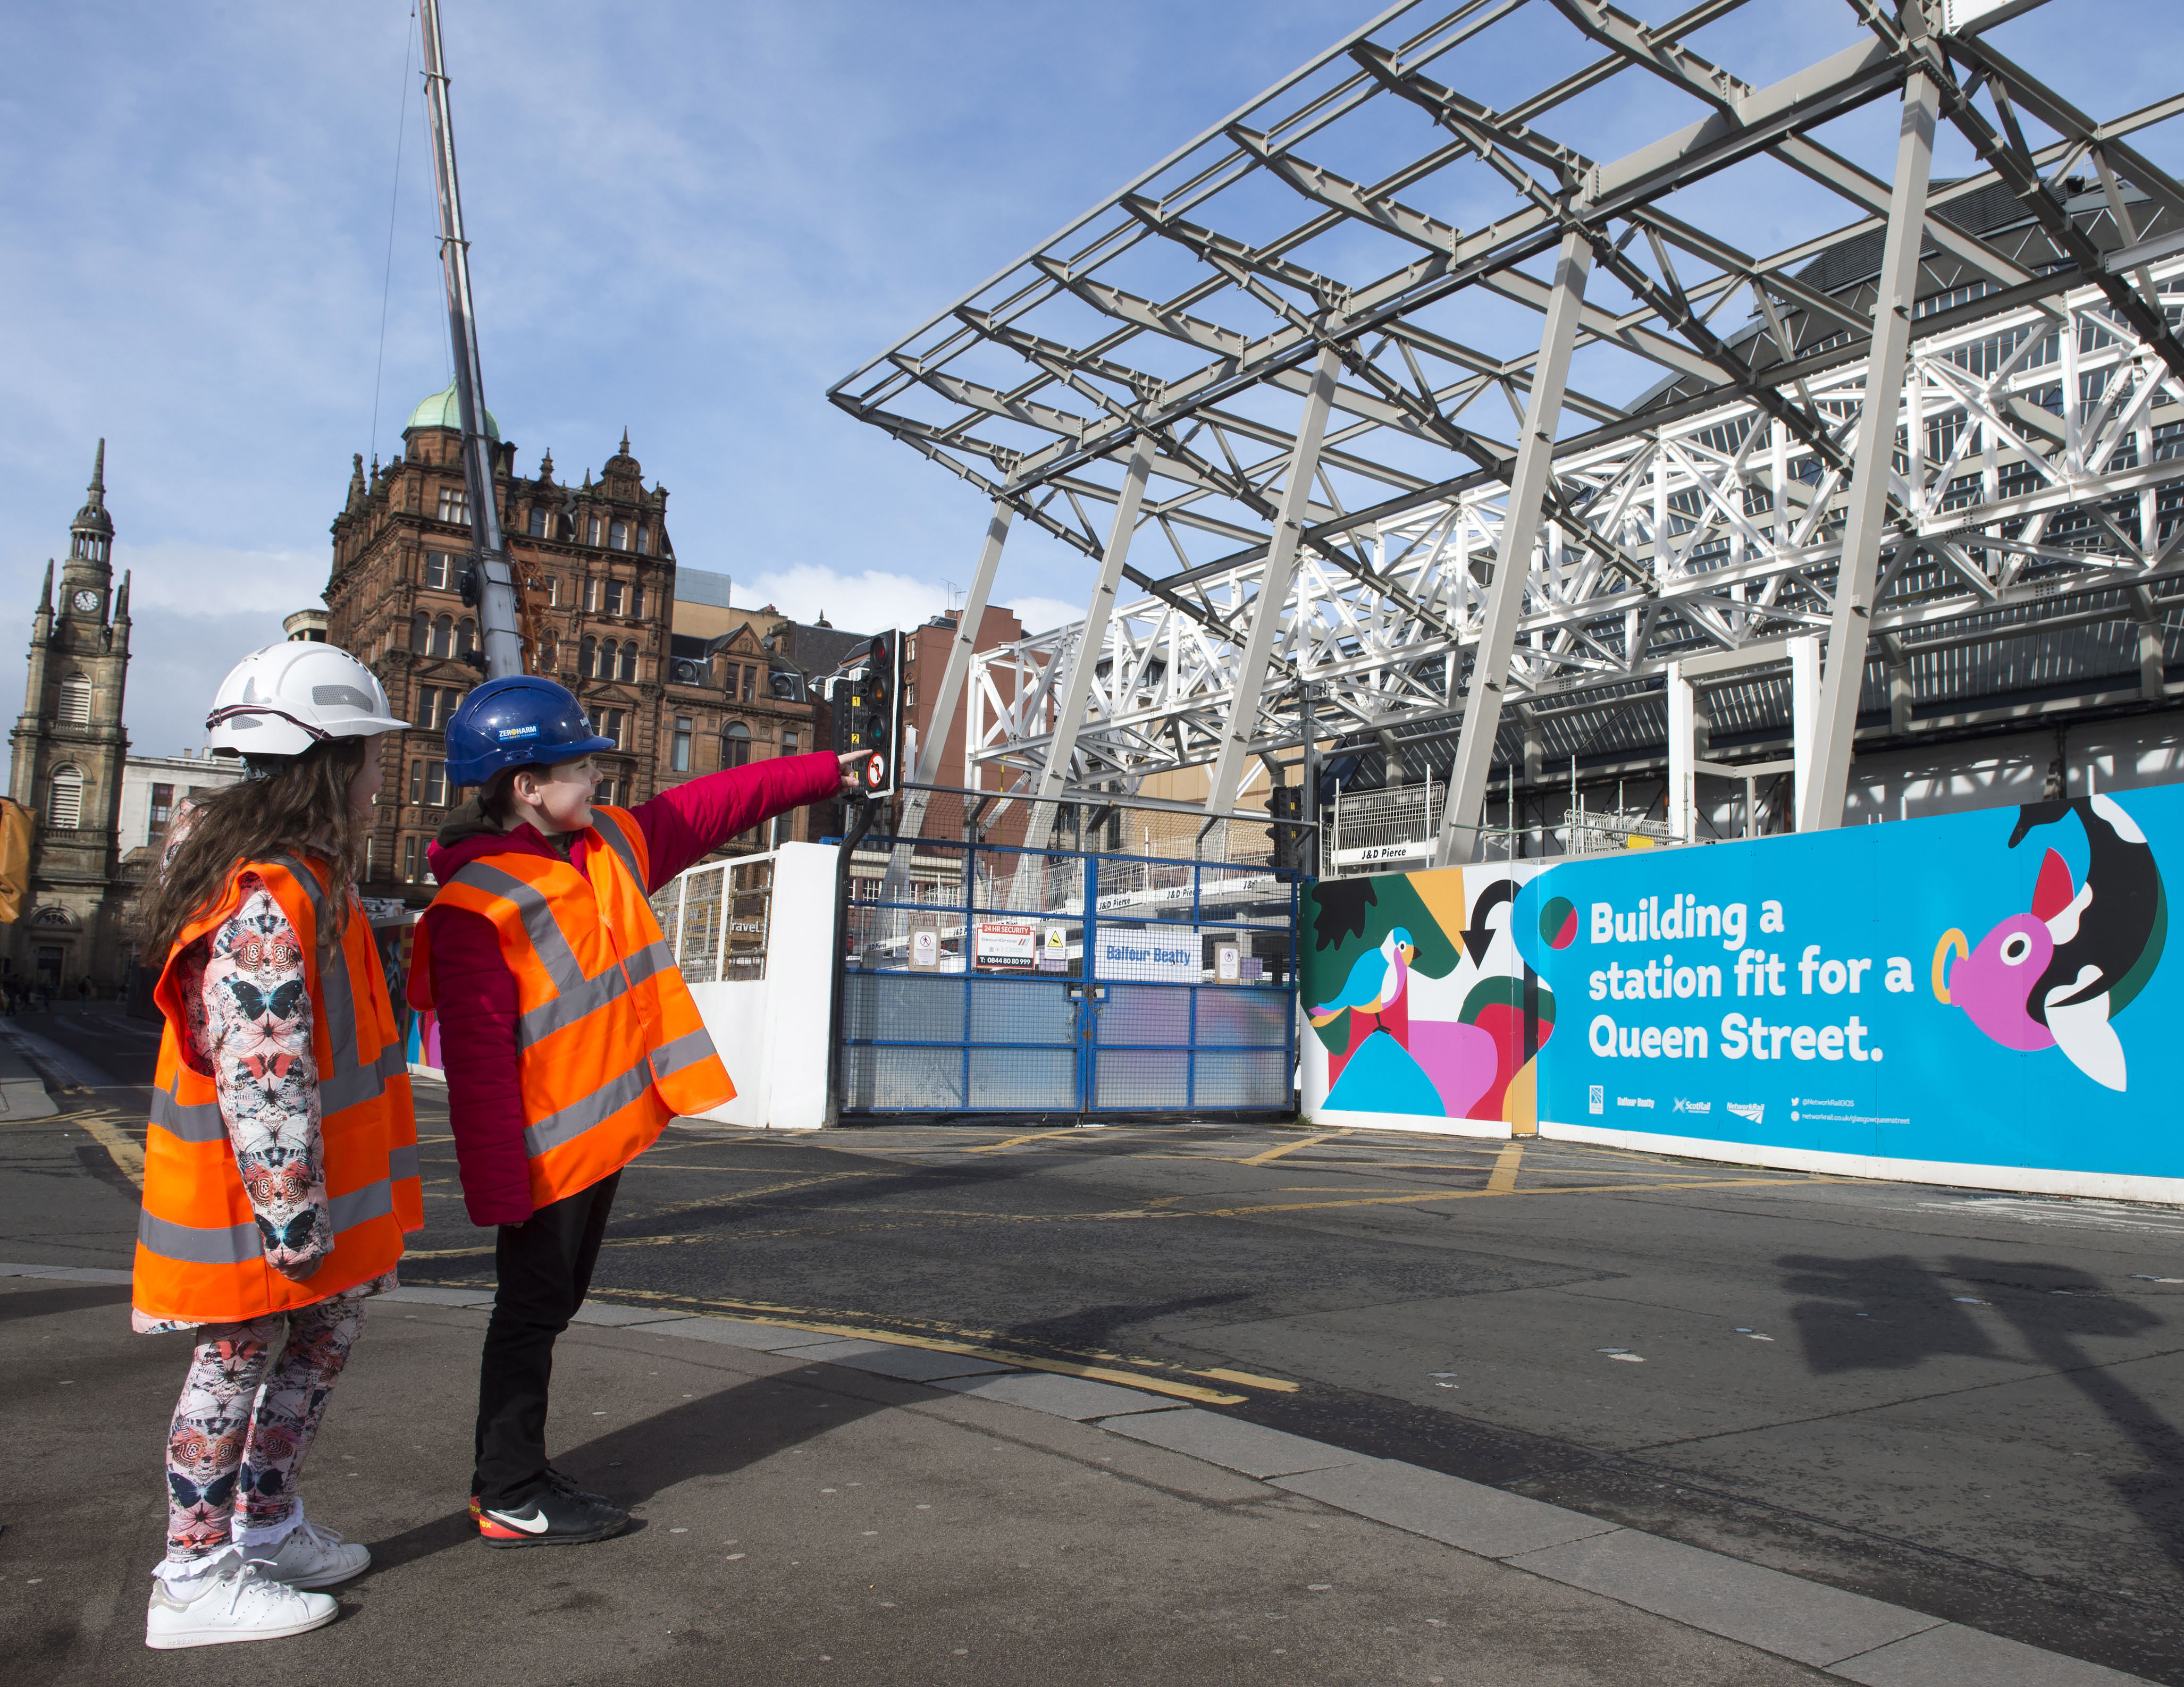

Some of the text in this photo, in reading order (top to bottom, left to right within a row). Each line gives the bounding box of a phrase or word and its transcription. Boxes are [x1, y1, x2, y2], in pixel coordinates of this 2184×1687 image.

[853, 735, 858, 743] 2
[1362, 848, 1406, 860] J&D Pierce
[1167, 890, 1180, 899] J&D
[1099, 898, 1130, 910] J&D Pierce
[732, 921, 760, 932] ravel
[1591, 893, 1785, 951] Building a
[1106, 945, 1191, 966] Balfour Beatty
[1589, 944, 1914, 1000] station fit for a
[1589, 1012, 1884, 1062] Queen Street.
[1617, 1096, 1654, 1109] Balfour Beatty
[1685, 1101, 1711, 1110] ScotRail
